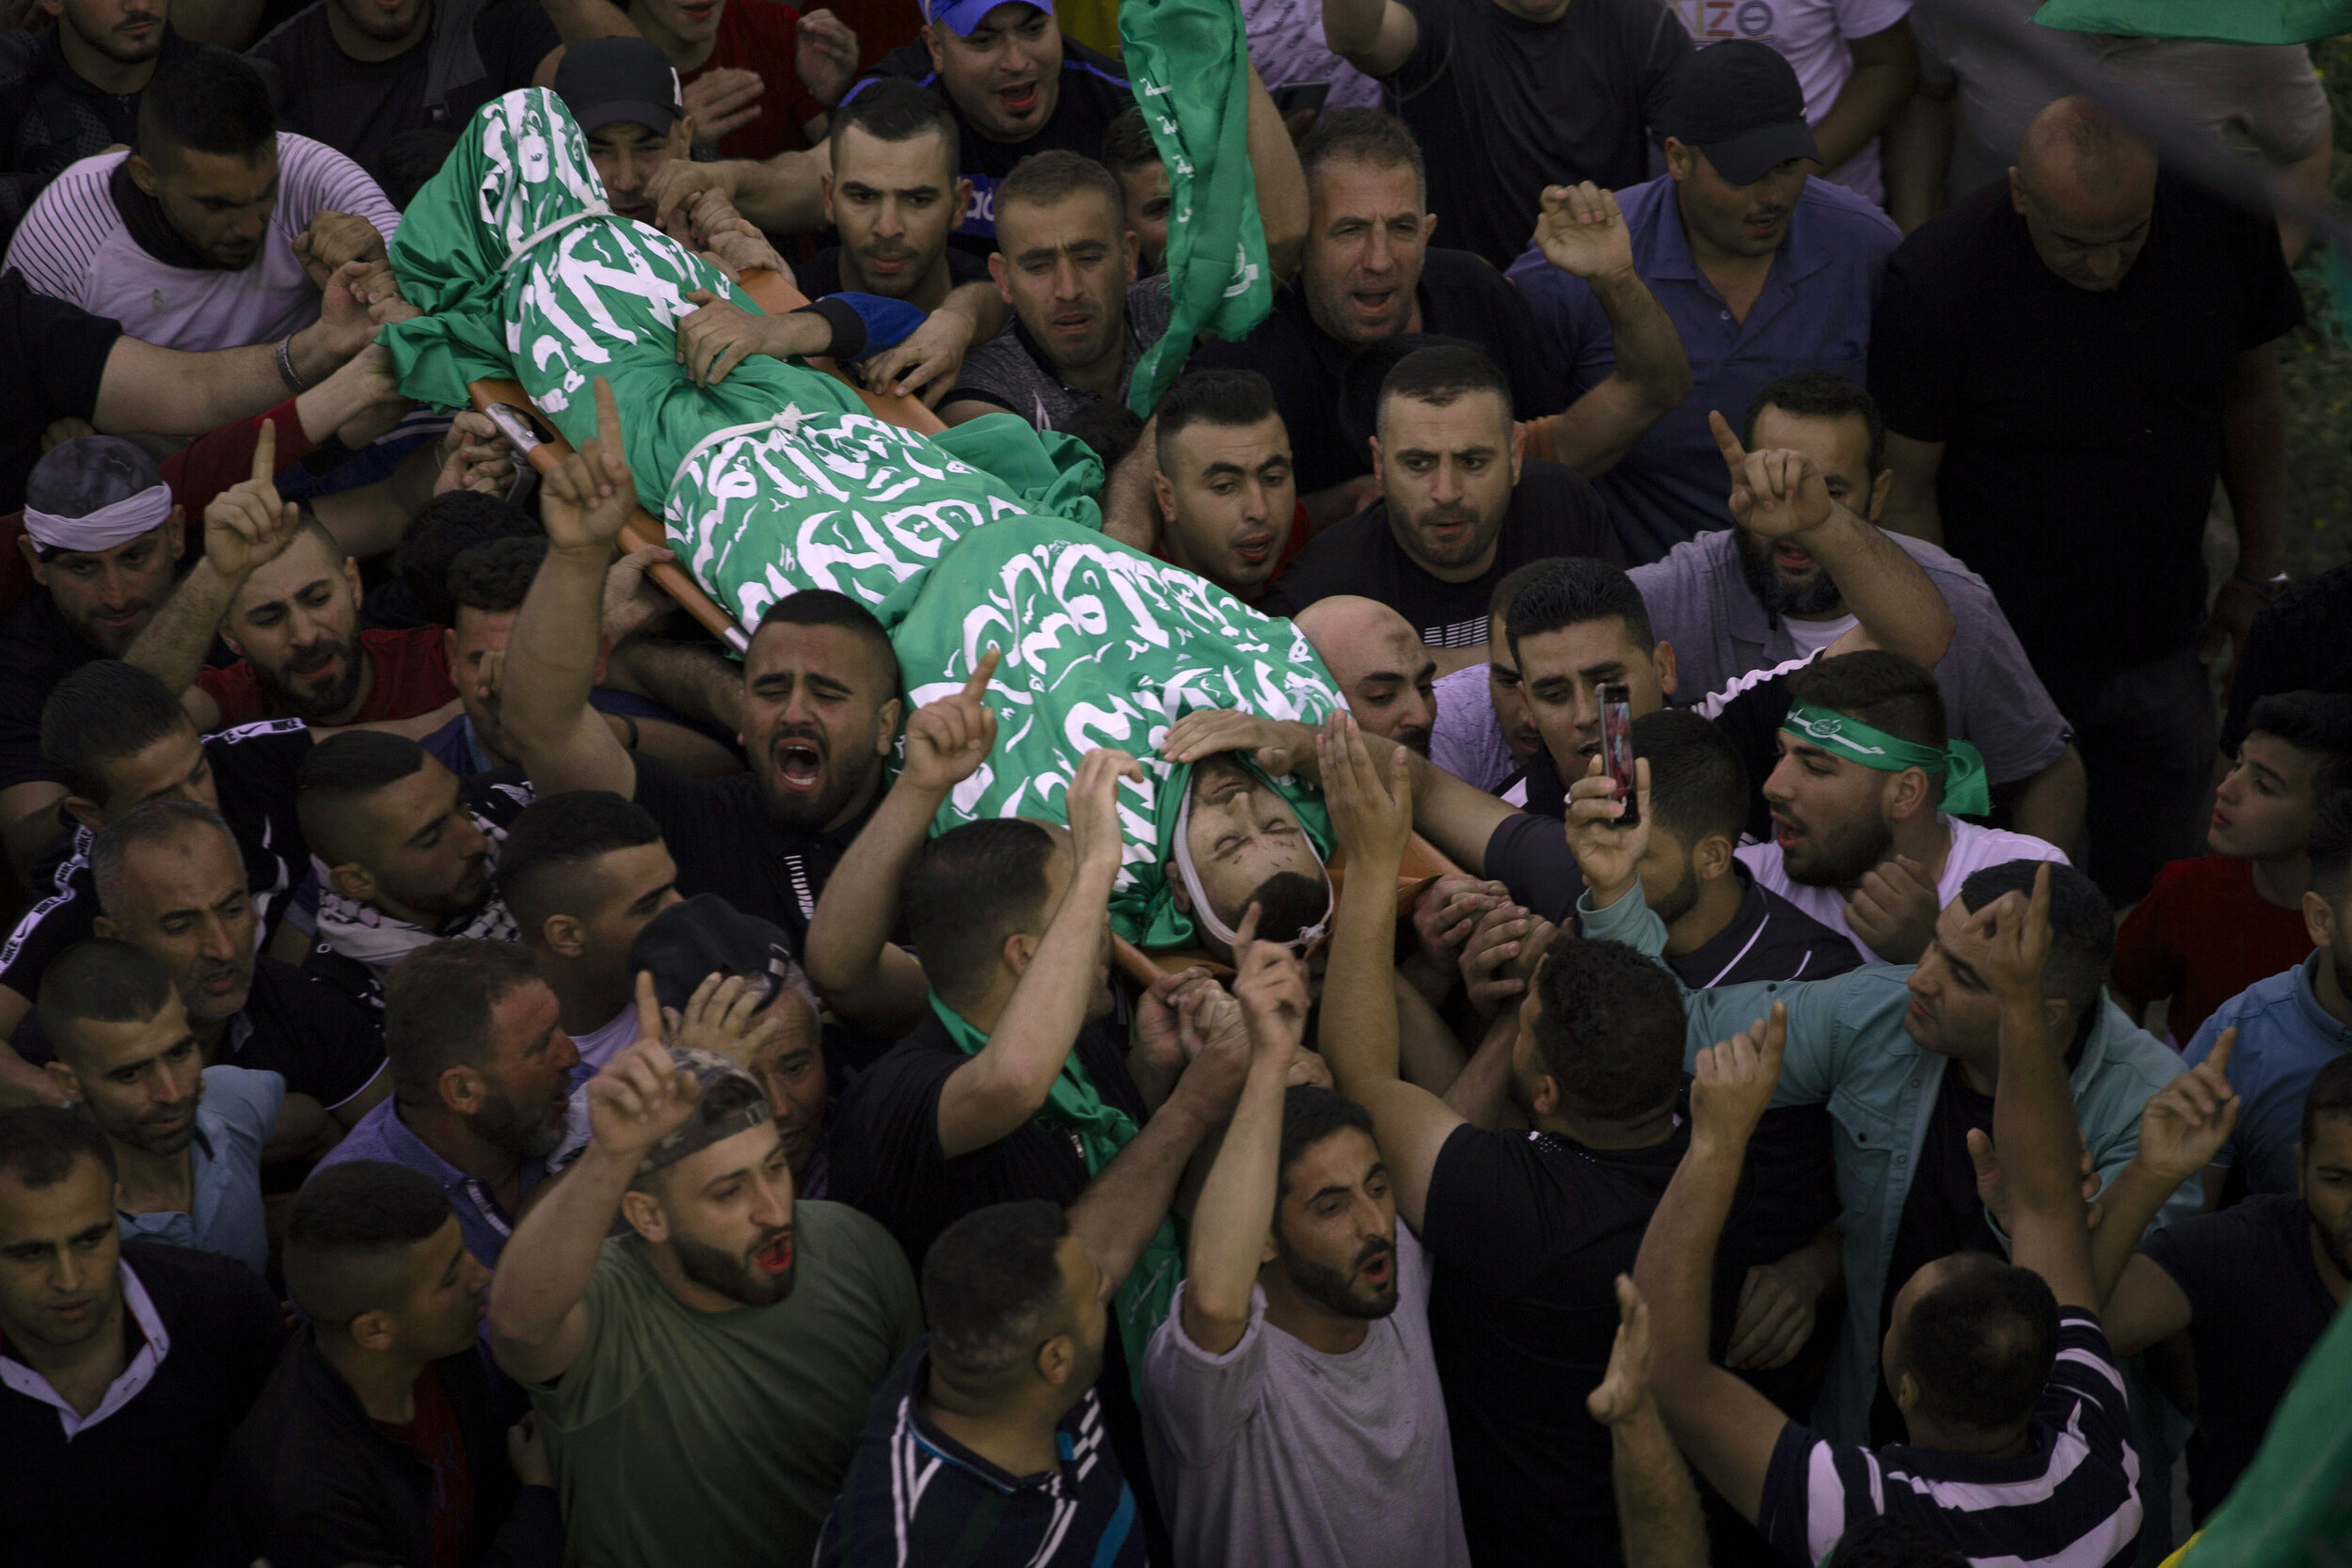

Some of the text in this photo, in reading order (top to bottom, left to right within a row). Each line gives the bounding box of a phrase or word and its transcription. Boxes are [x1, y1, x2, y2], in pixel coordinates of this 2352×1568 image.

[78, 830, 93, 857] NIKE
[57, 863, 75, 882] NIK
[34, 897, 58, 914] NIKE
[3, 941, 19, 964] NIKE
